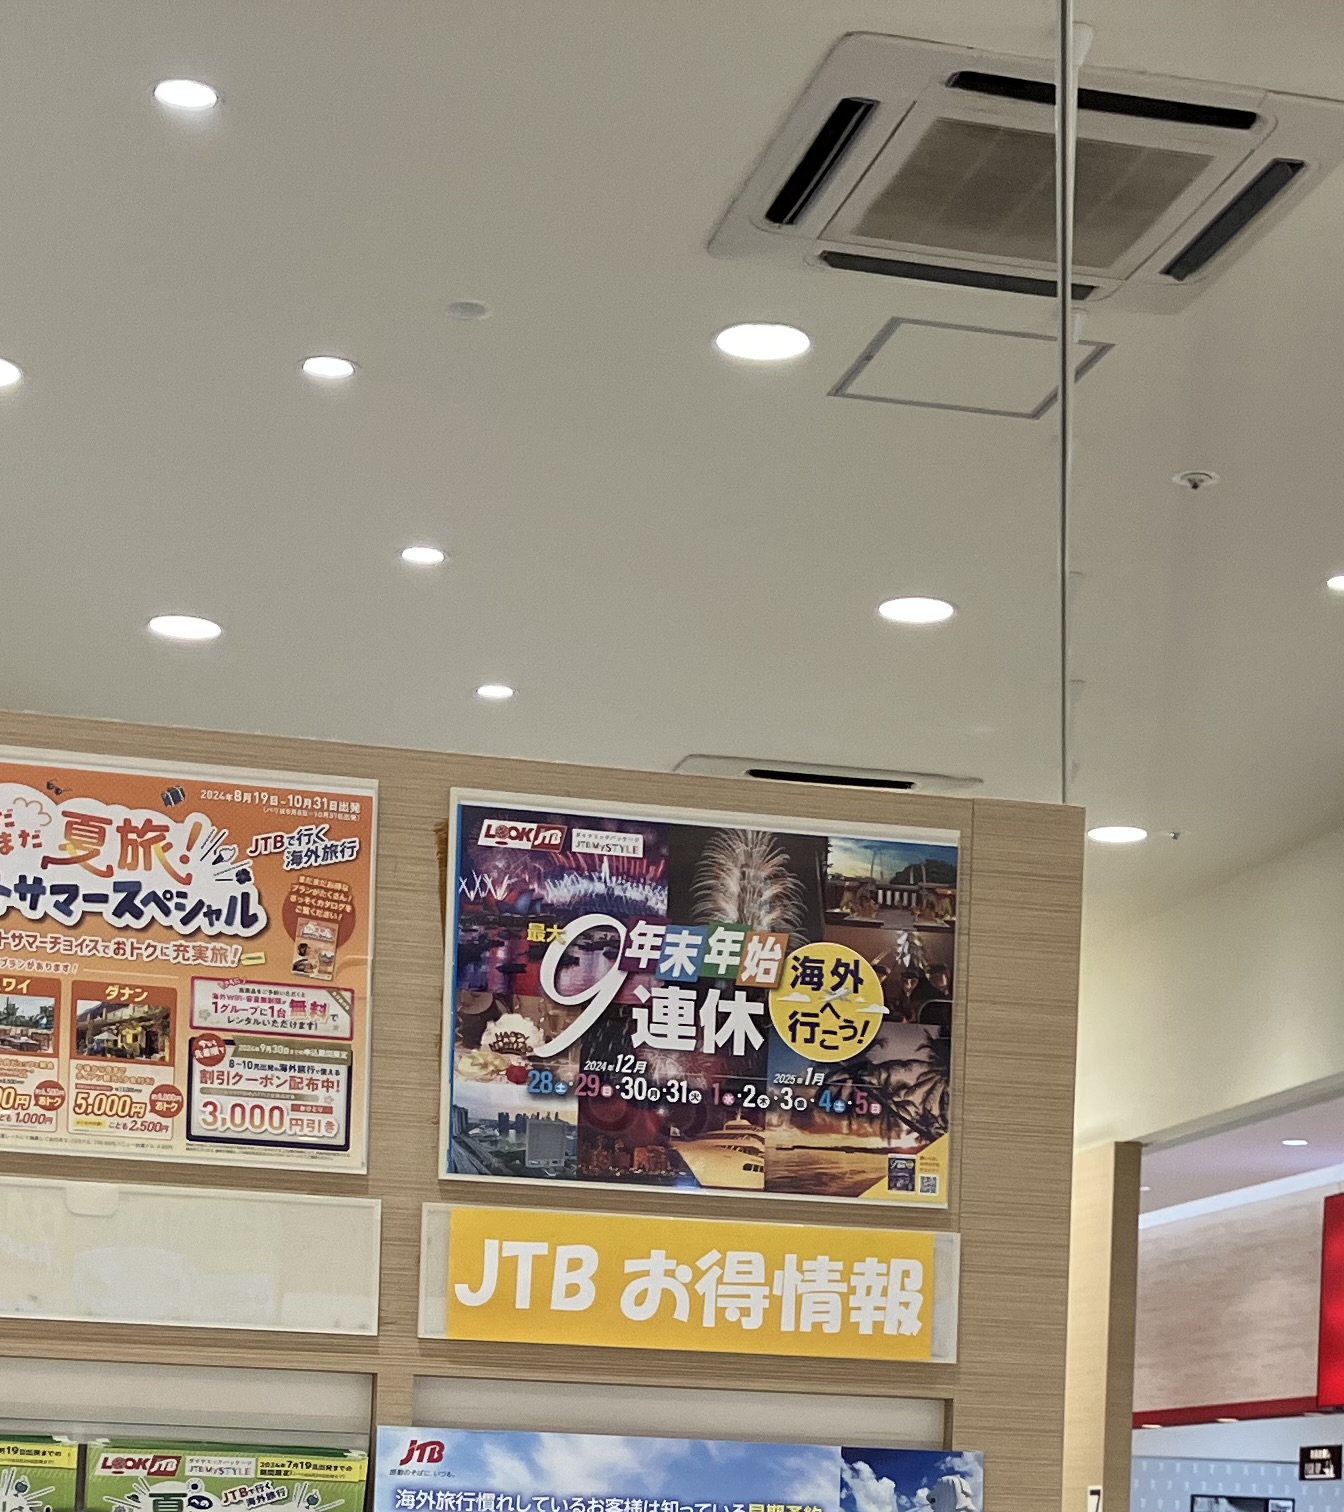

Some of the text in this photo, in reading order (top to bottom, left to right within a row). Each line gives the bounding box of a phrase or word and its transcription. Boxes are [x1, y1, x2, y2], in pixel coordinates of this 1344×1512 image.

[284, 840, 357, 869] 海外旅行
[624, 921, 785, 984] 年末年始
[105, 984, 149, 1002] ダナン
[790, 954, 864, 994] 海外
[631, 987, 765, 1057] 連休
[455, 1239, 924, 1338] JTB お得情報
[399, 1438, 446, 1466] JTB
